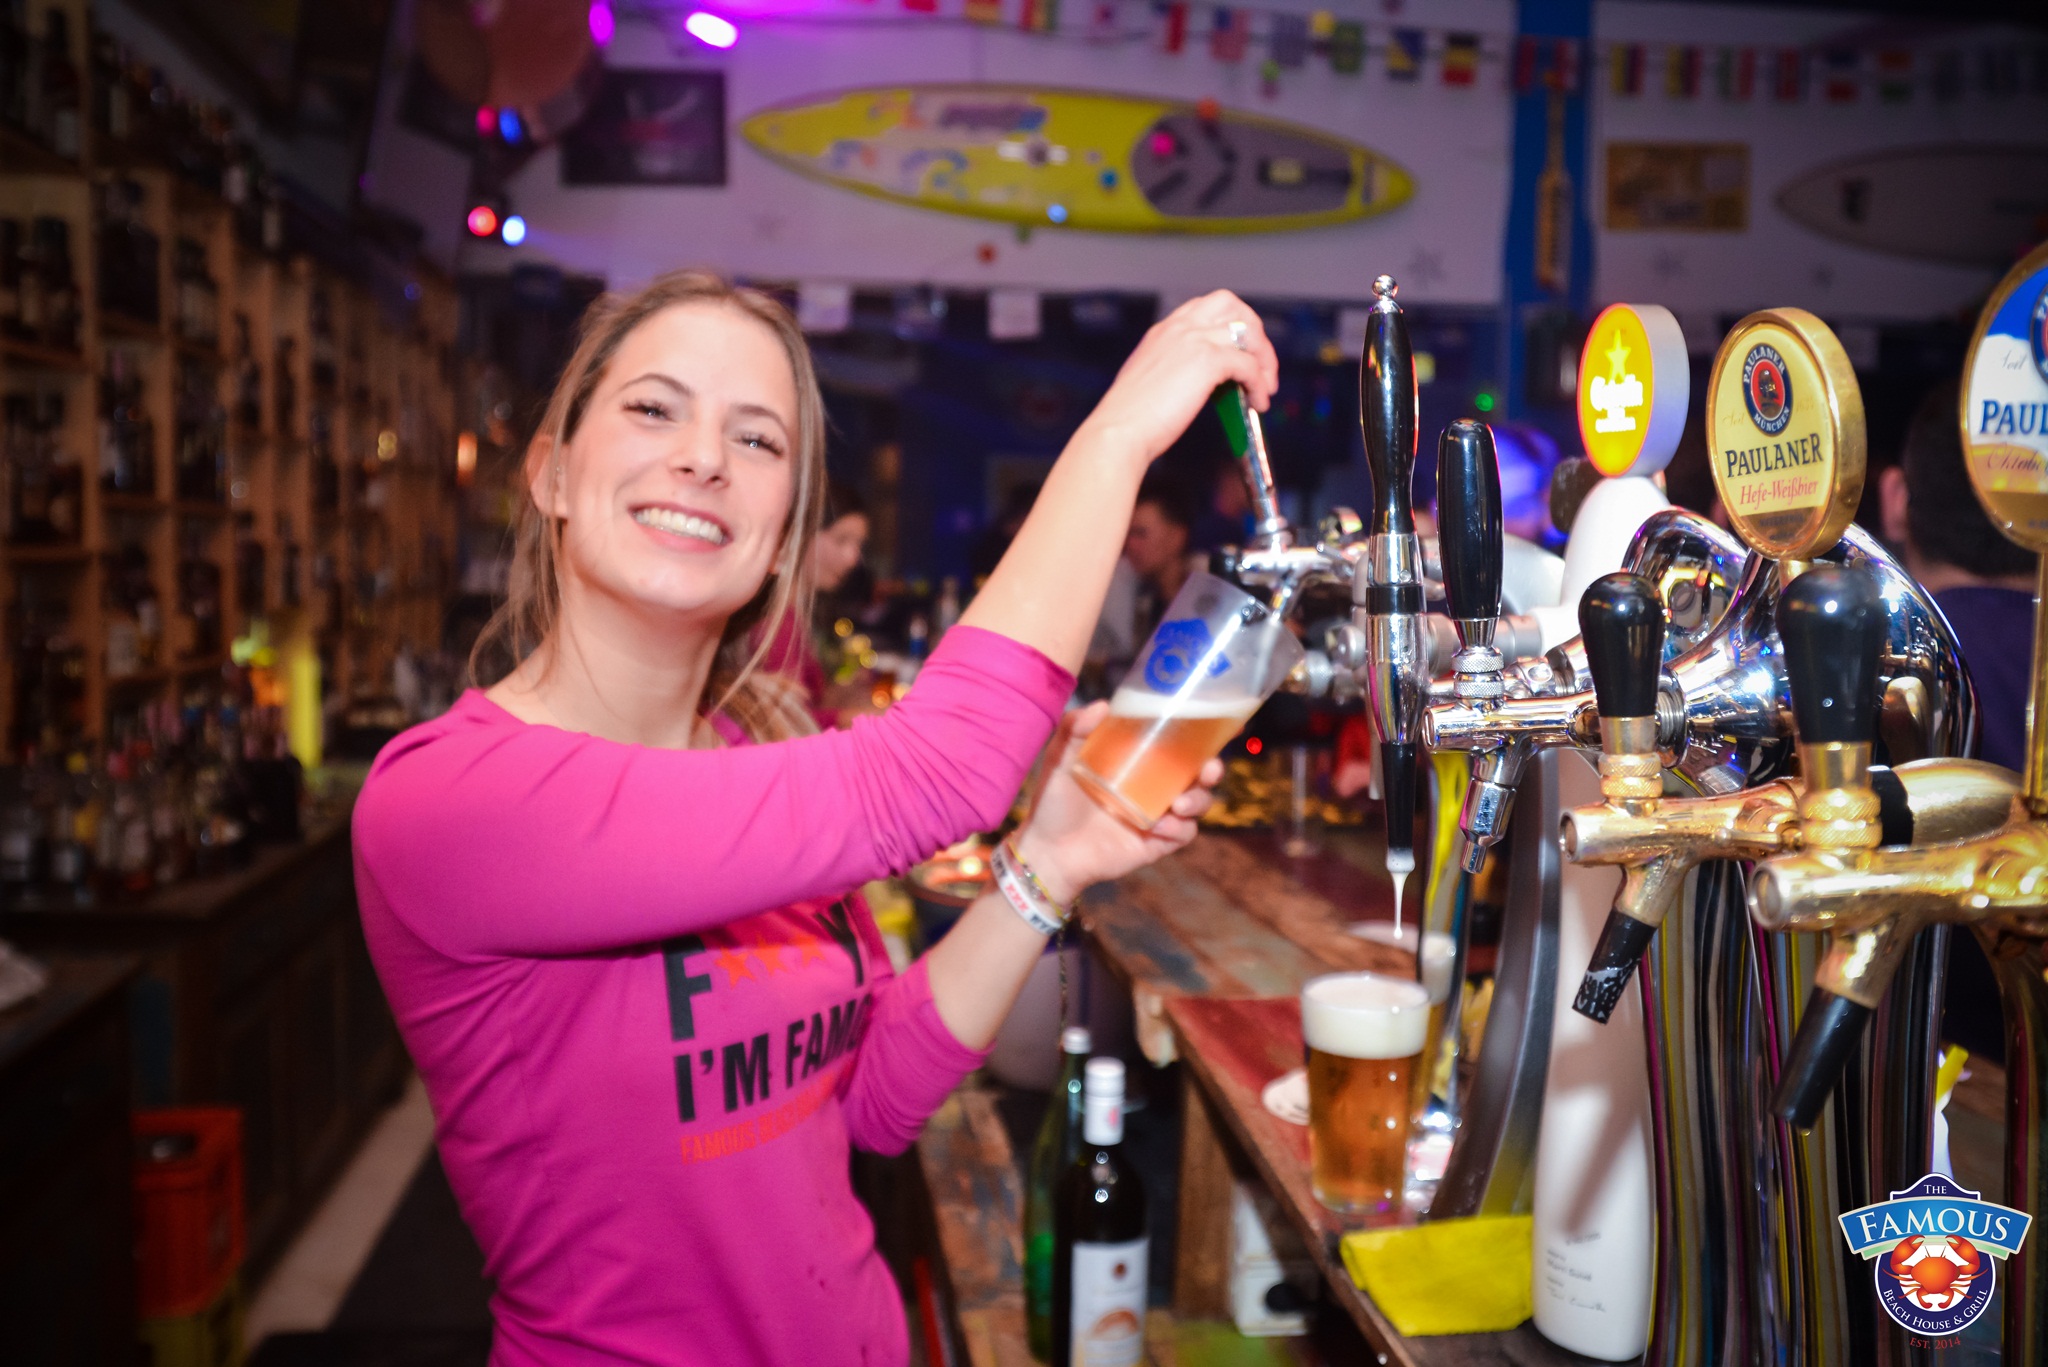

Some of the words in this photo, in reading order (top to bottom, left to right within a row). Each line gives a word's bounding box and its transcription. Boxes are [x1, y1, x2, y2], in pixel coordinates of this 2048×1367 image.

[1743, 345, 1786, 384] PAULANER
[1725, 432, 1824, 478] PAULANER
[674, 1032, 770, 1124] I'M
[680, 1119, 756, 1166] FAMOUS
